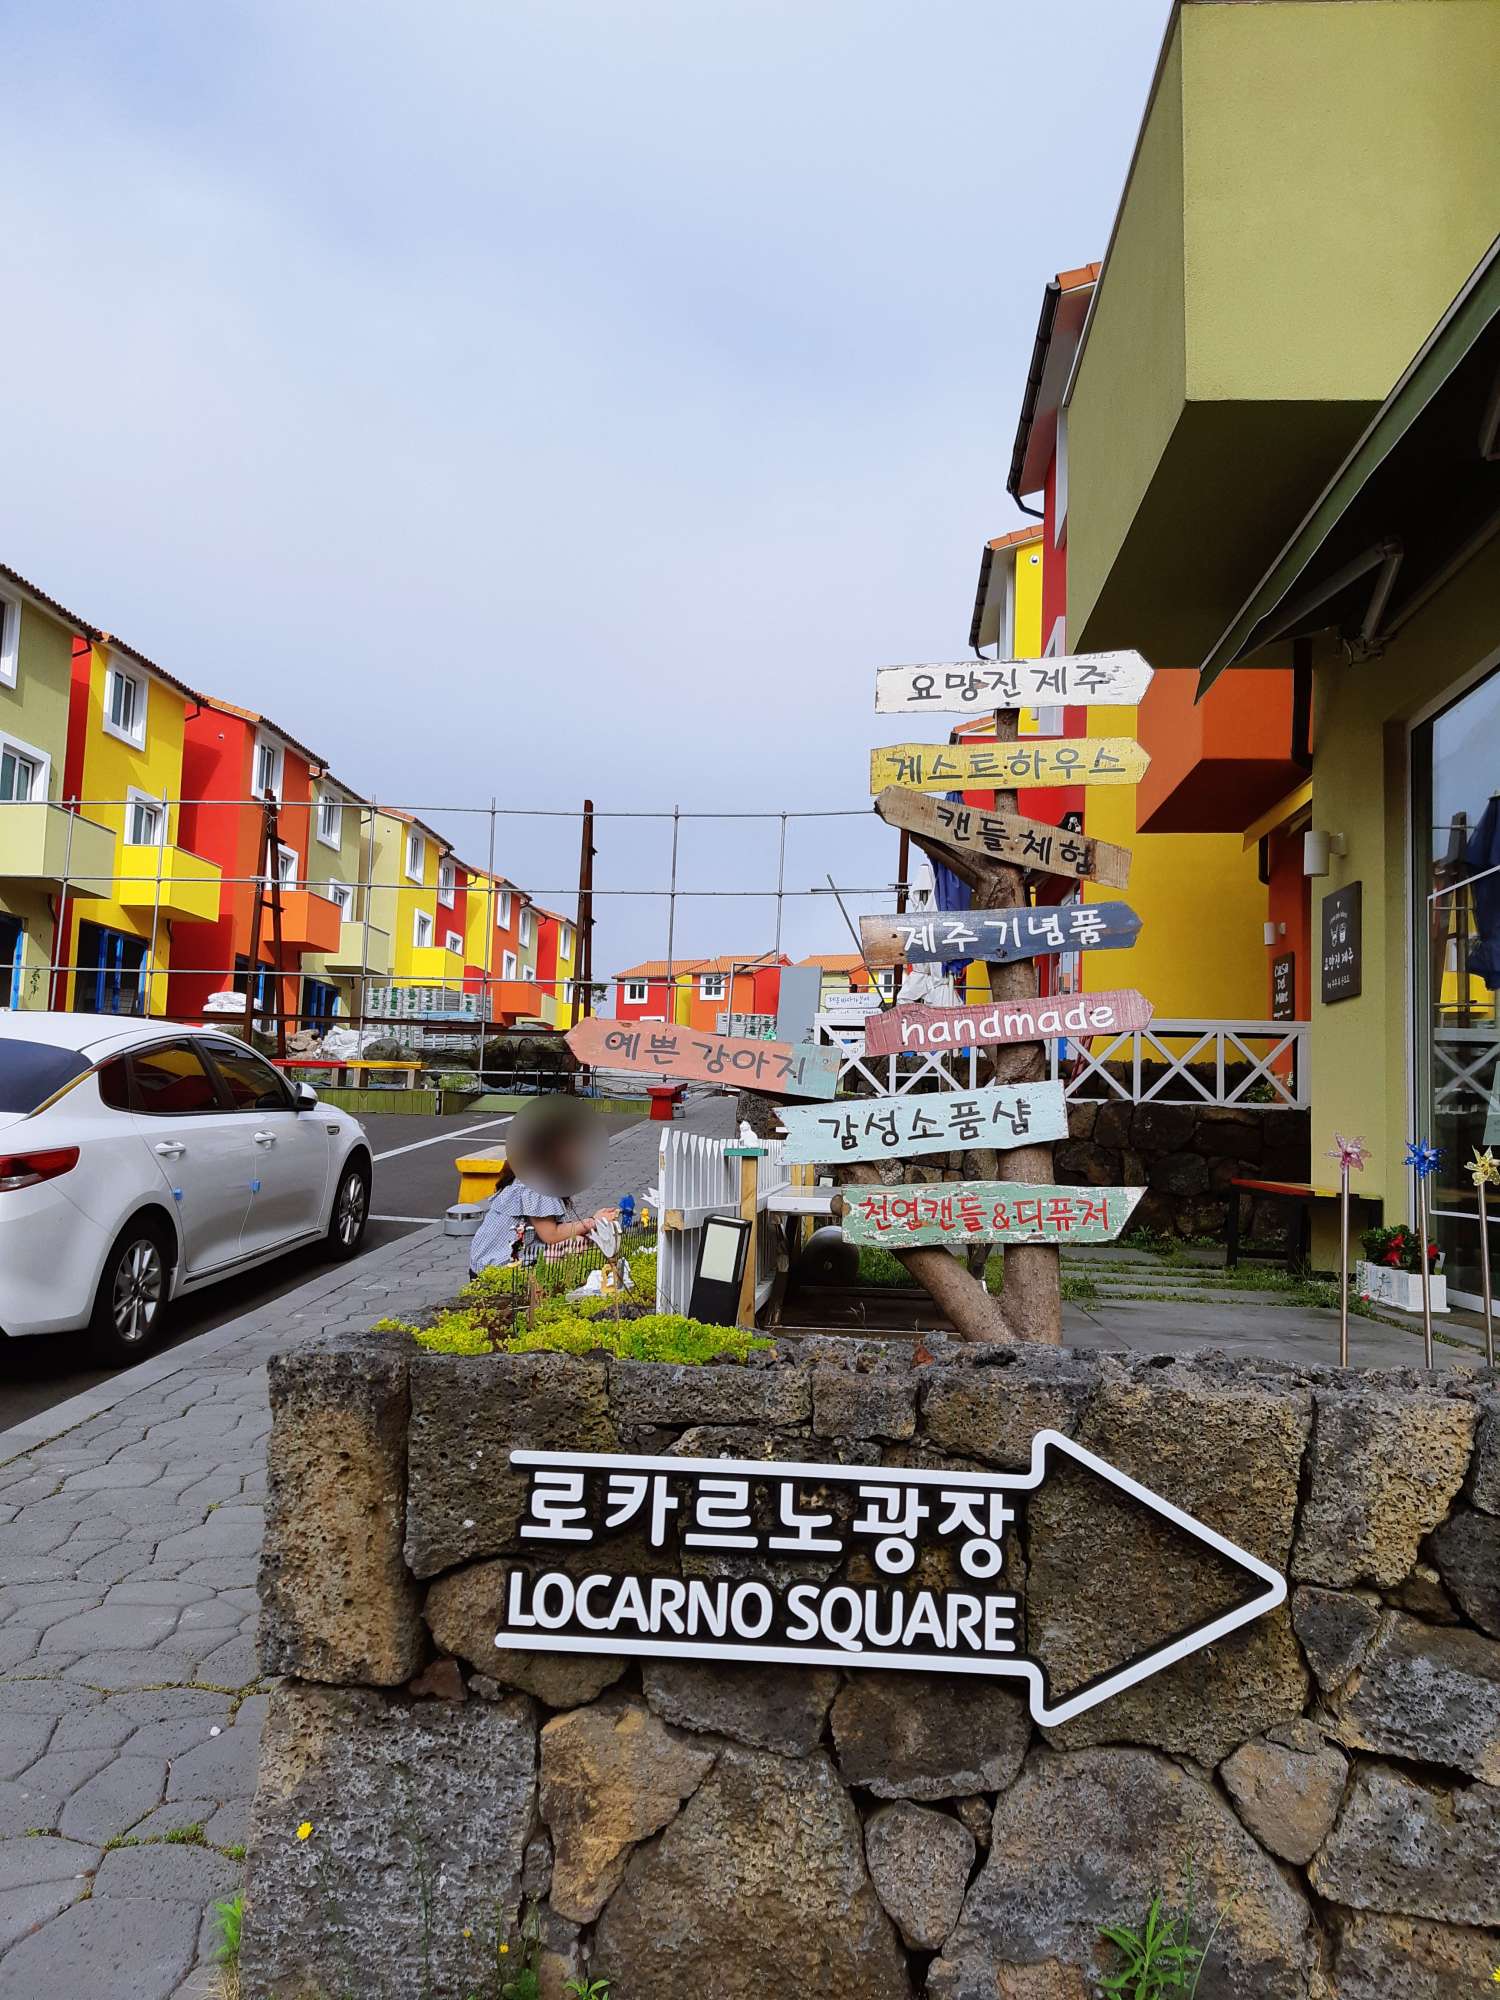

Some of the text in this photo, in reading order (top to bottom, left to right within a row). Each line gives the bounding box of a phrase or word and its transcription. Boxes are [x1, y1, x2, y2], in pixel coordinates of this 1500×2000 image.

[906, 665, 1107, 702] 요망진 제주
[886, 746, 1126, 784] 게스트하우스
[900, 1001, 1116, 1045] handmade
[604, 1030, 807, 1085] 예쁜 강아지
[506, 1571, 1017, 1652] LOCARNO SQUARE
